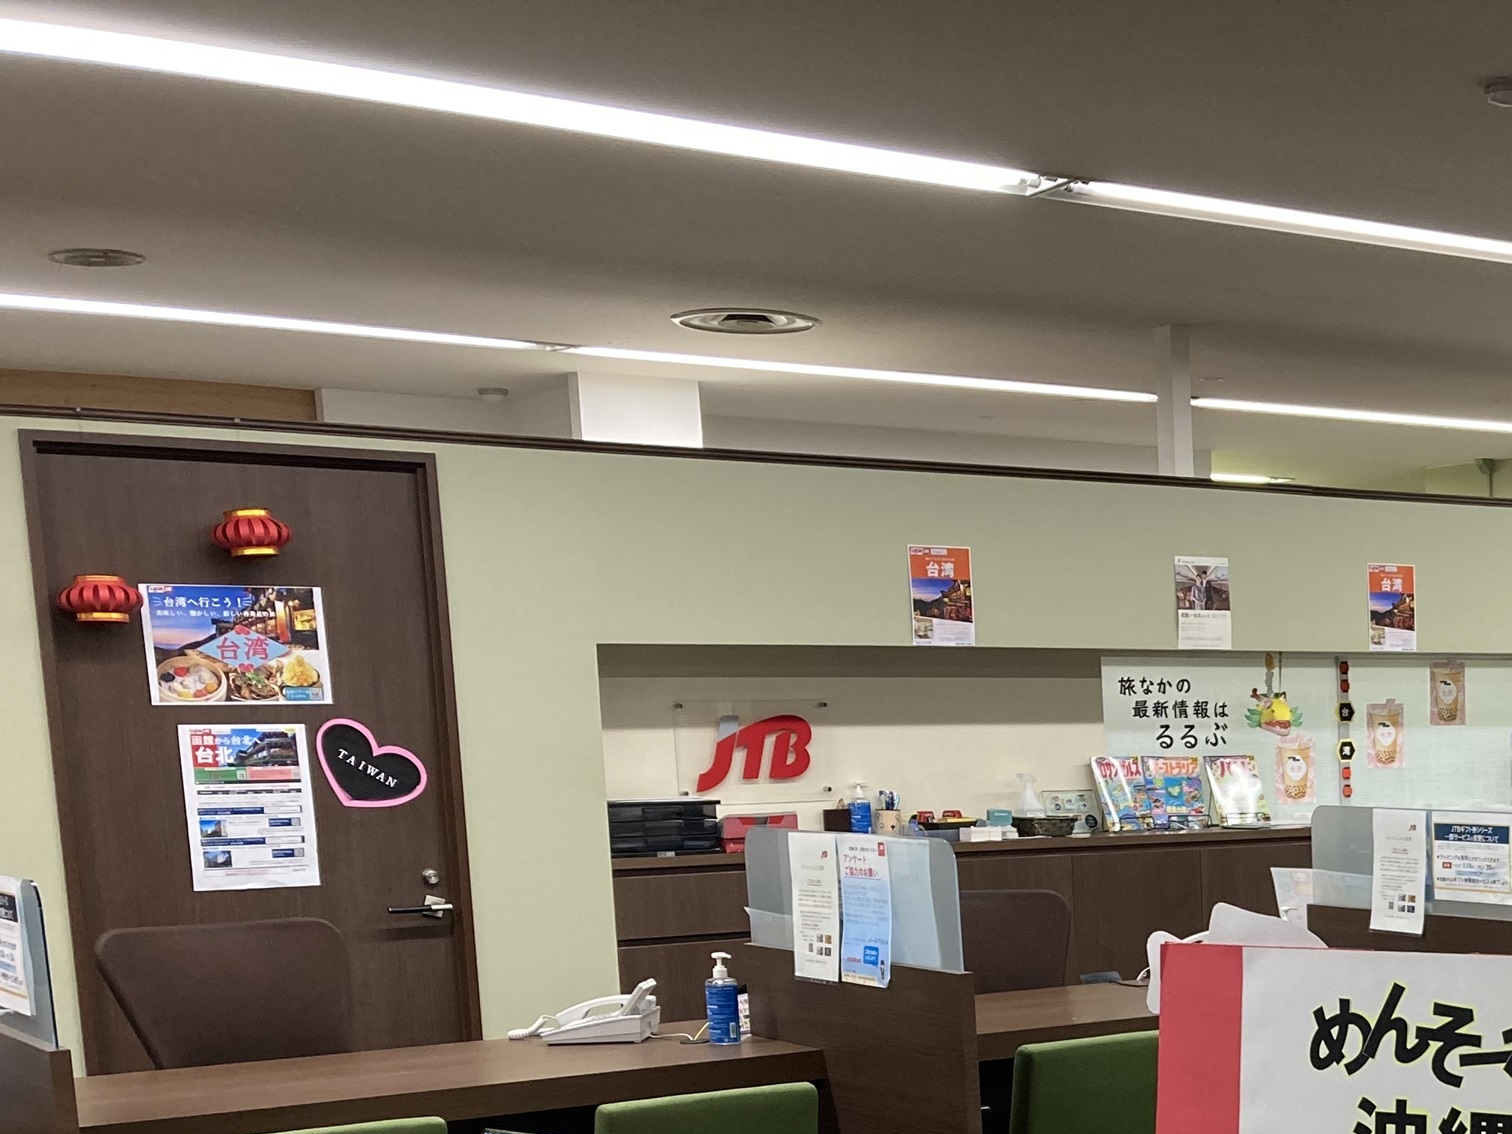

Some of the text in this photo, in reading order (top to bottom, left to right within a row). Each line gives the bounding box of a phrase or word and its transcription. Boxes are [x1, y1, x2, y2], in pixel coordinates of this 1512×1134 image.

[926, 561, 954, 577] 台湾
[1380, 577, 1403, 592] 台湾
[217, 637, 269, 660] 台湾
[1118, 677, 1191, 696] 旅なかの
[1132, 701, 1228, 719] 最新情報は
[1157, 723, 1227, 749] るるぶ
[195, 746, 234, 764] 台北
[696, 714, 812, 793] JTB
[338, 749, 397, 788] TAIWAN
[843, 854, 866, 863] アンケート
